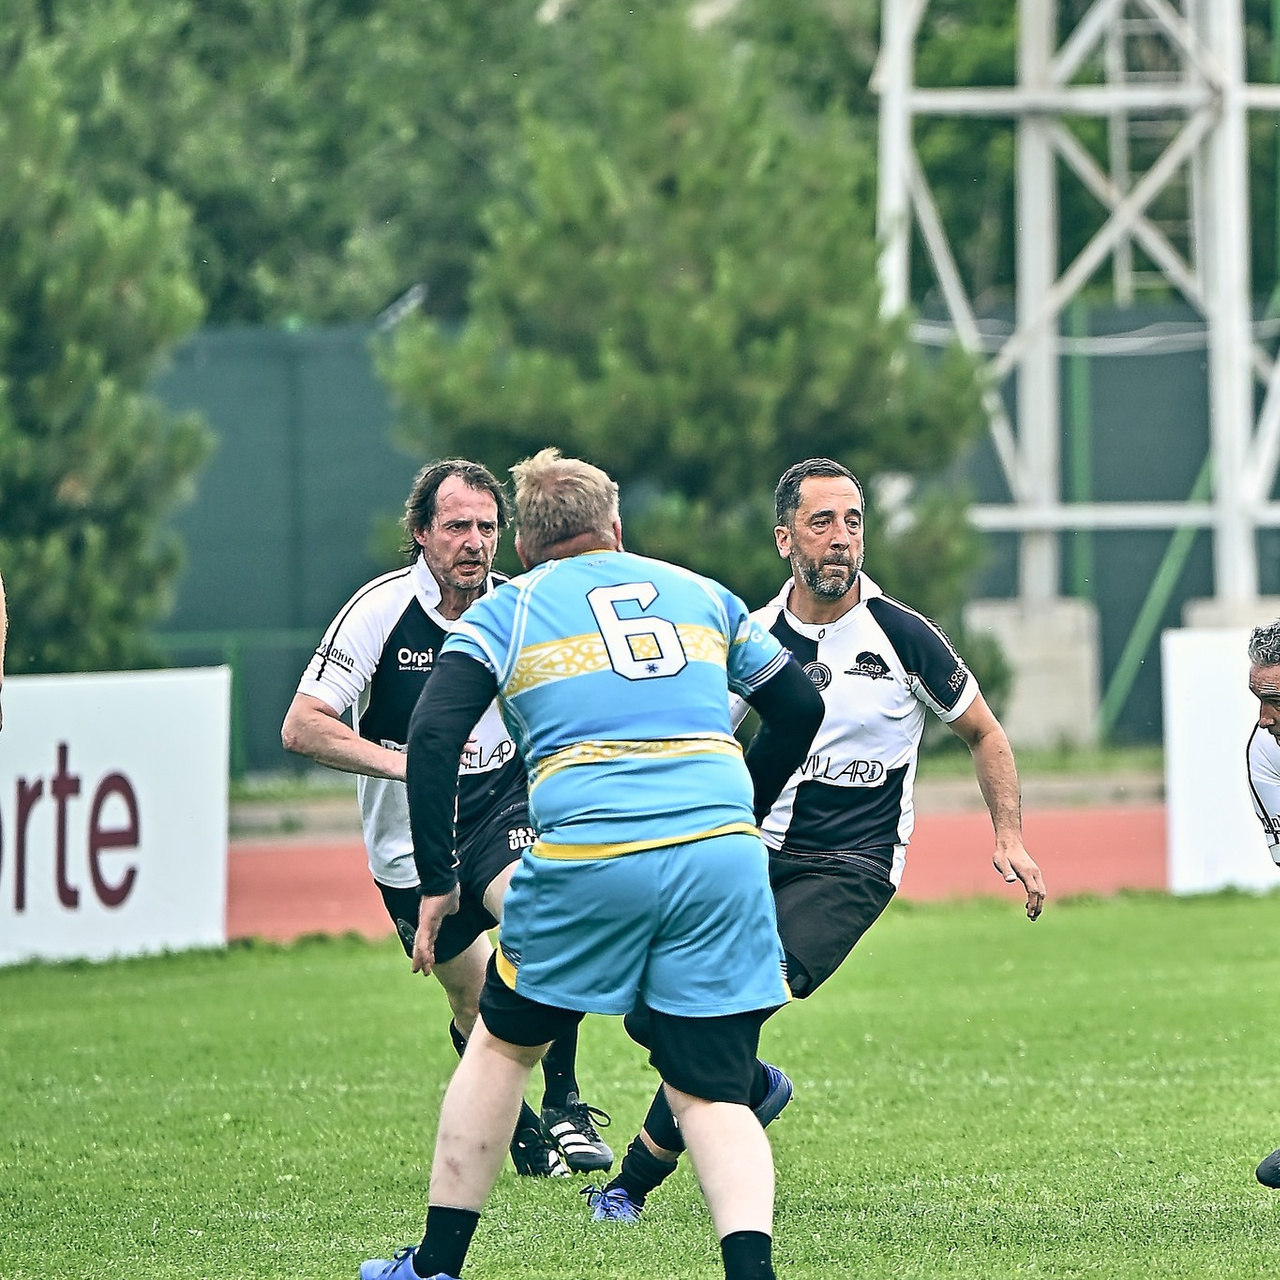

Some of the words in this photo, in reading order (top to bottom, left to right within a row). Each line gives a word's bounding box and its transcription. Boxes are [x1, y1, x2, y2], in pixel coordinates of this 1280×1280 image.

[397, 647, 434, 667] Orpi
[586, 581, 688, 681] 6
[799, 754, 884, 783] VILLARD
[0, 741, 141, 911] rte
